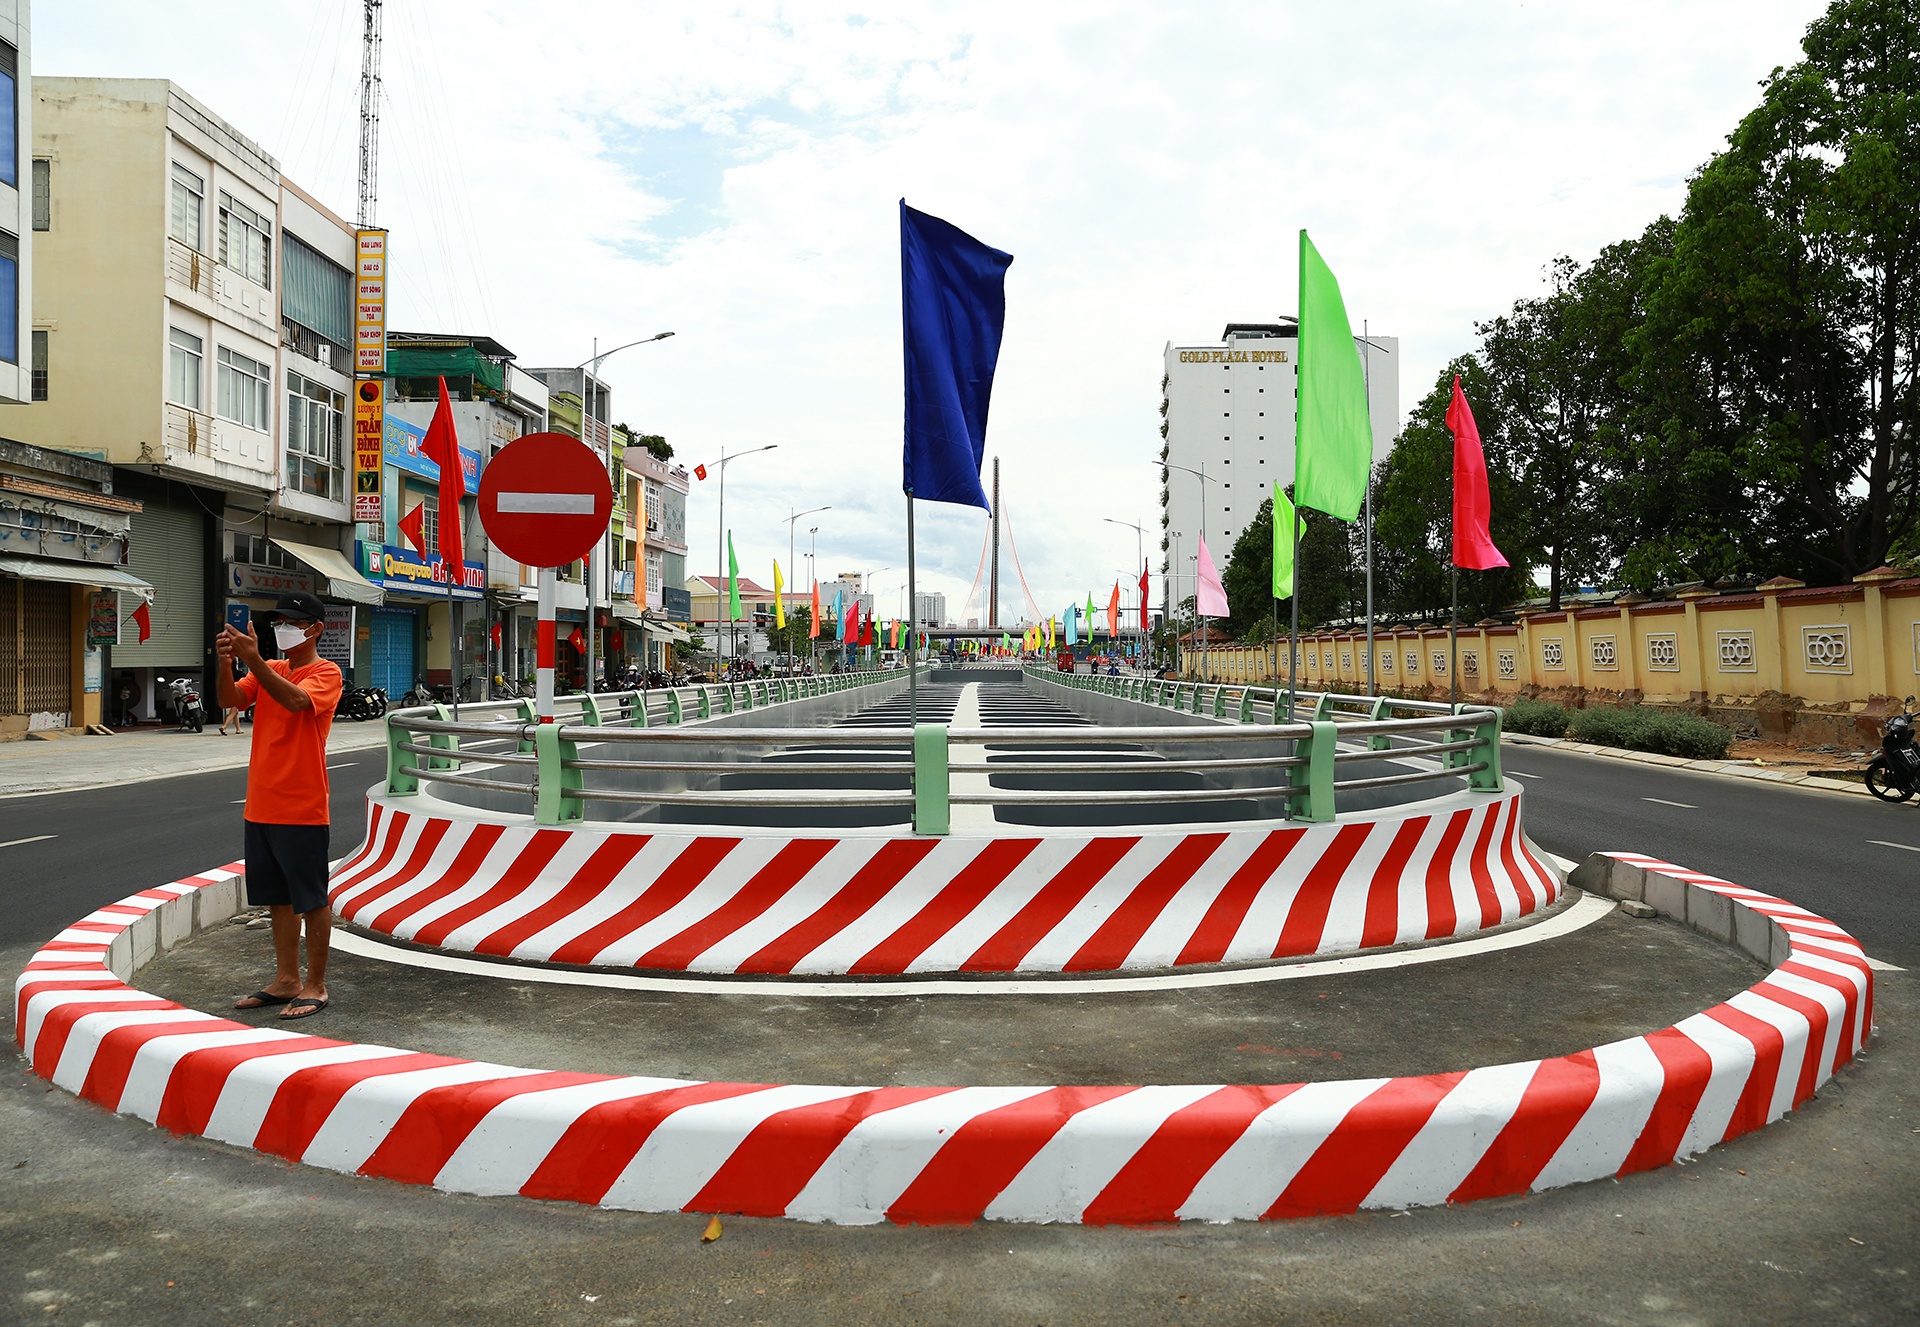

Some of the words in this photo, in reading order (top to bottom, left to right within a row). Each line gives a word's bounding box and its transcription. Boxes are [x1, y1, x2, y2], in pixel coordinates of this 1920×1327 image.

[1179, 351, 1209, 363] GOLD
[1212, 351, 1249, 363] PLAZA
[1252, 351, 1288, 363] HOTEL
[357, 404, 375, 413] LƯƠNG
[377, 405, 381, 413] Y
[356, 412, 381, 433] TRẦN
[357, 434, 380, 451] ĐÌNH
[358, 454, 378, 470] VẠN
[356, 495, 380, 504] 20
[384, 553, 416, 581] Quảng
[416, 560, 431, 579] cáo
[249, 574, 294, 590] VIỆT
[297, 580, 310, 591] Y
